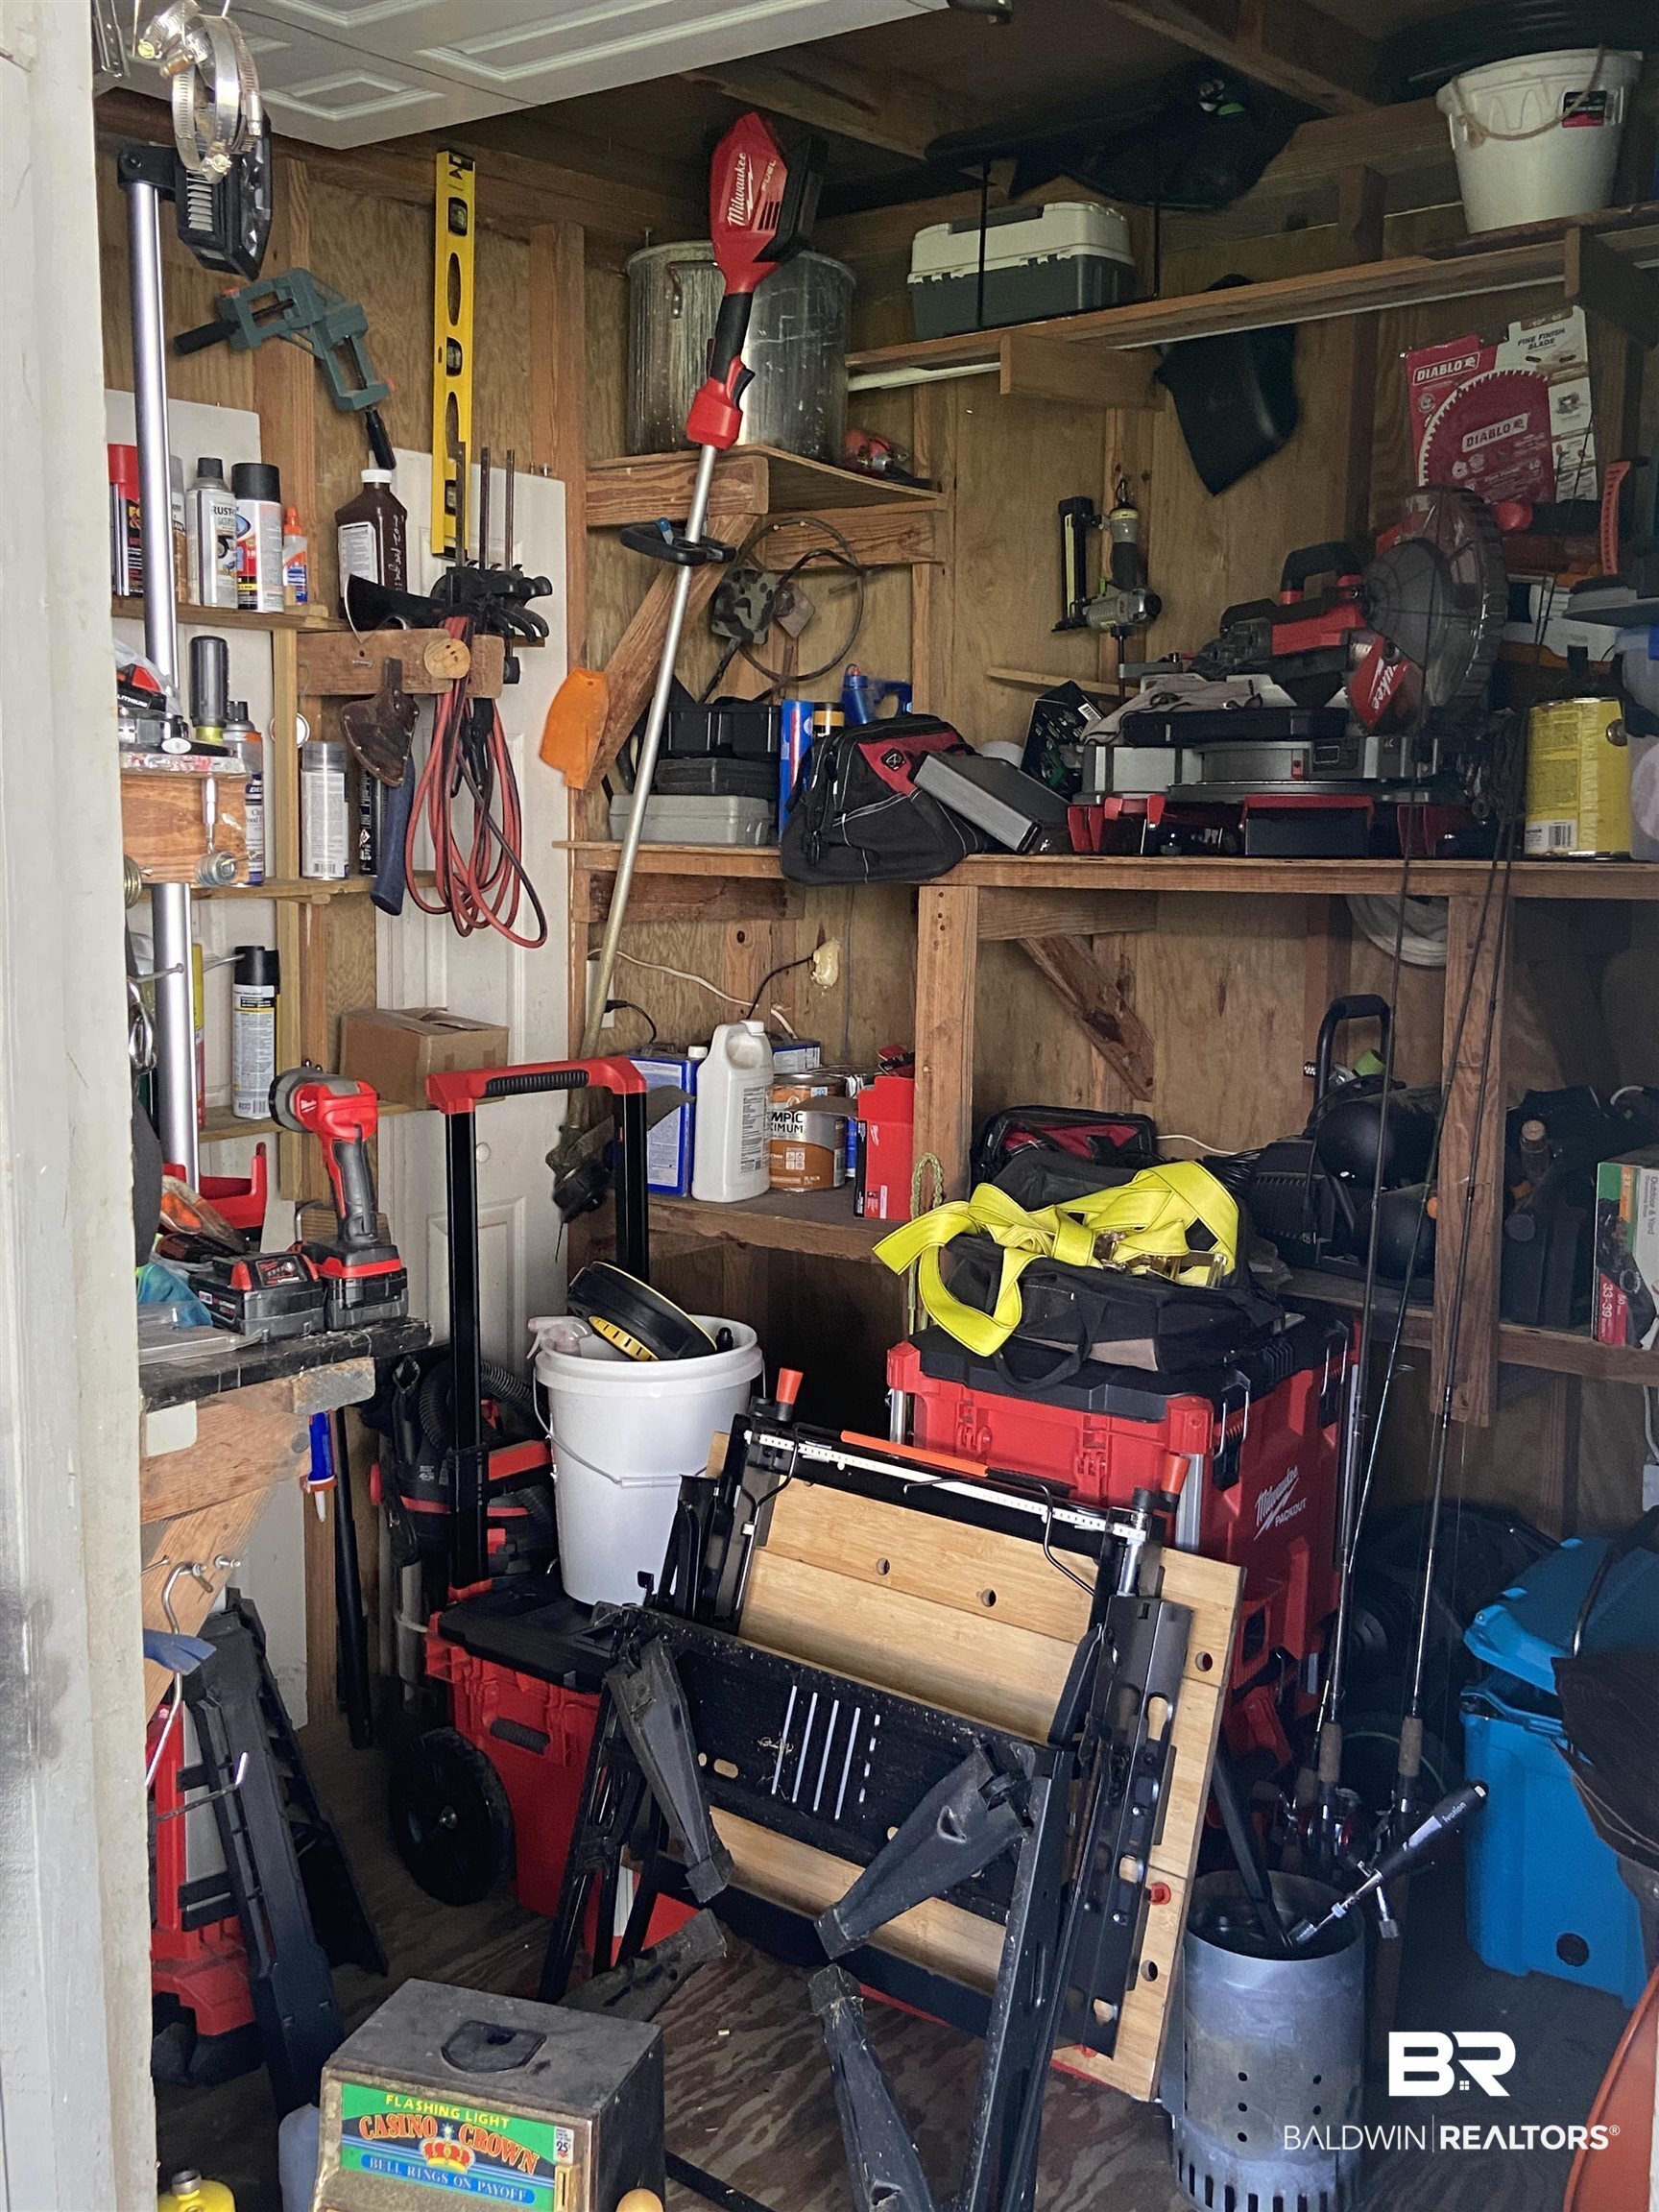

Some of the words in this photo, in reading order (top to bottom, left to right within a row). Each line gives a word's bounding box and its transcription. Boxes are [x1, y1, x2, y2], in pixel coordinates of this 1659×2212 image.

[727, 153, 746, 227] Milwaukee
[761, 159, 776, 192] FUEL
[1416, 359, 1461, 382] DIABLO
[1466, 422, 1511, 447] DIABLO
[1648, 1176, 1658, 1208] Outdoor
[1647, 1217, 1656, 1235] Yard
[1255, 1466, 1299, 1527] Milwaukee
[1275, 1497, 1307, 1527] PACKOUT
[385, 2094, 461, 2120] FLASHING
[465, 2110, 510, 2129] LIGHT
[359, 2113, 438, 2140] CASINO
[459, 2123, 540, 2176] CROWN
[369, 2157, 402, 2175] BELL
[407, 2165, 448, 2185] RINGS
[453, 2175, 471, 2189] ON
[477, 2180, 527, 2202] PAYOFF
